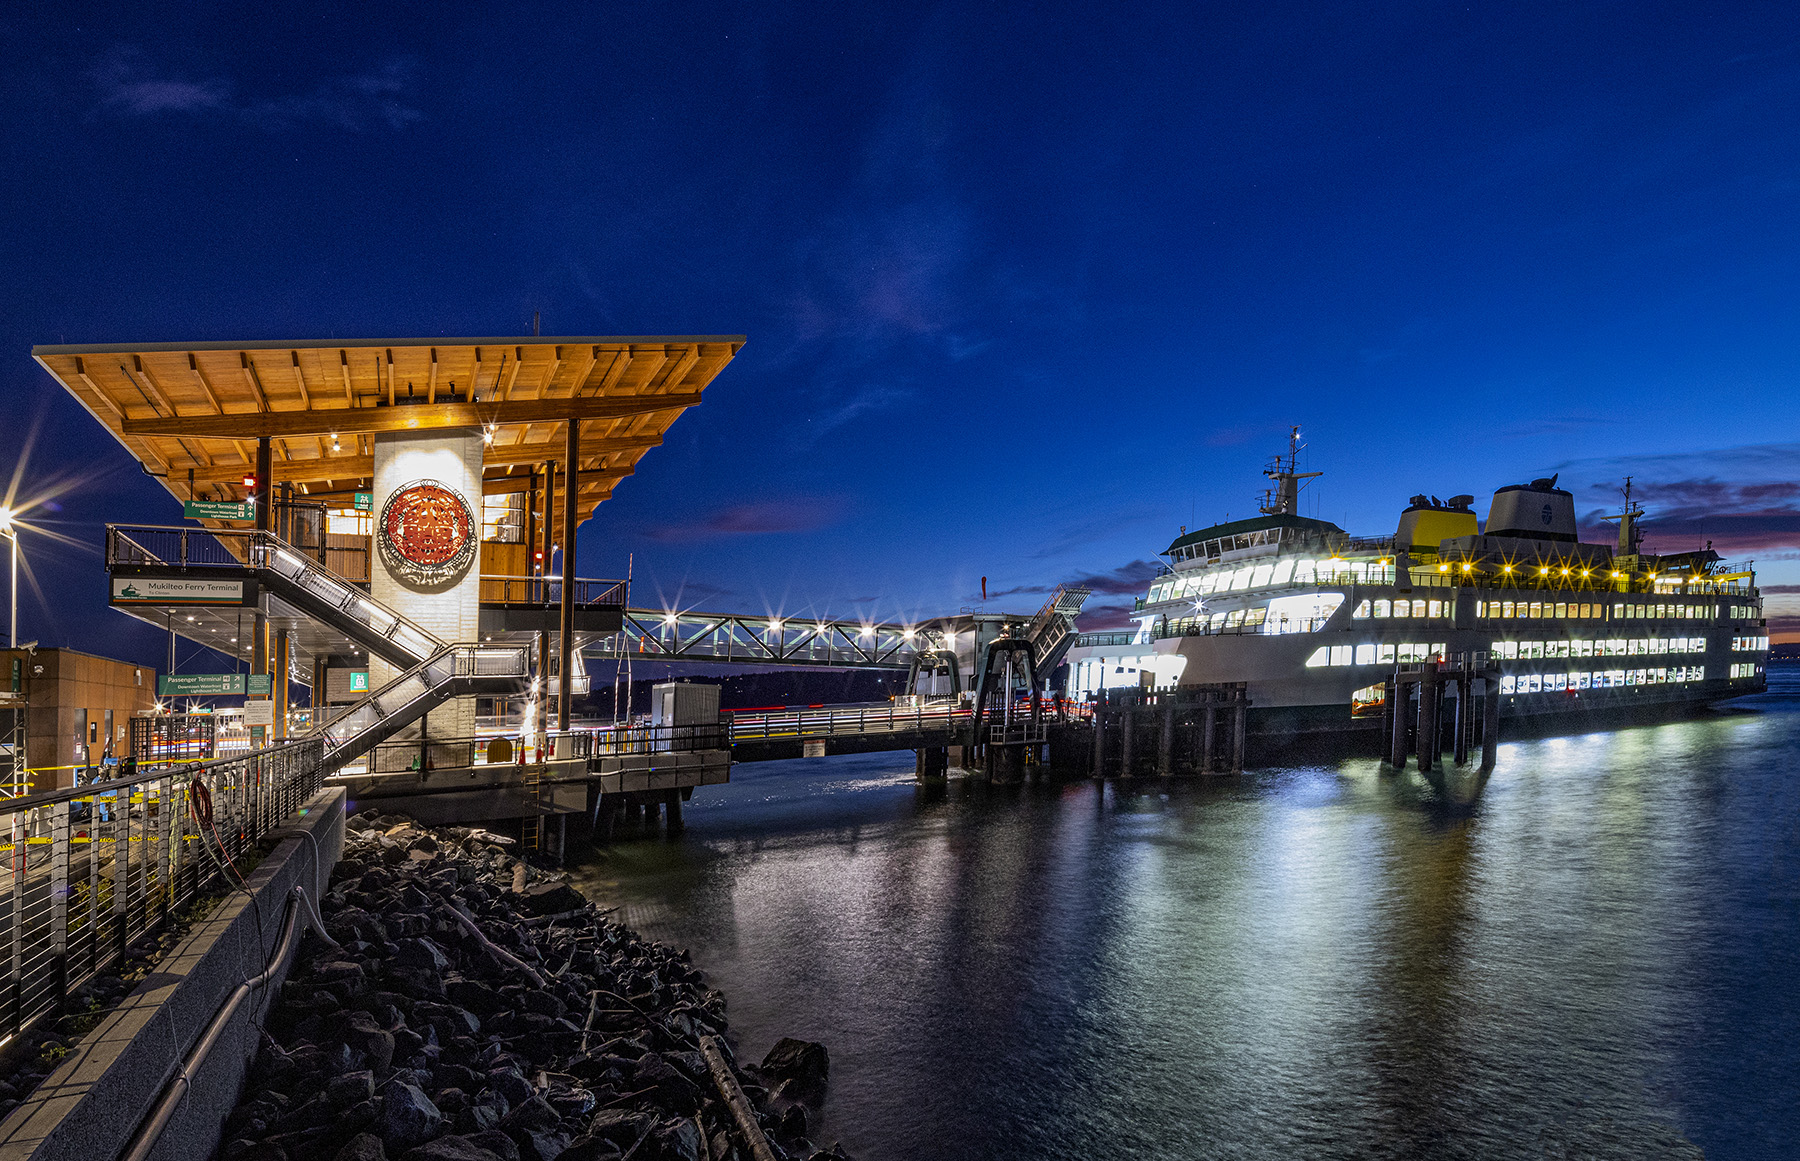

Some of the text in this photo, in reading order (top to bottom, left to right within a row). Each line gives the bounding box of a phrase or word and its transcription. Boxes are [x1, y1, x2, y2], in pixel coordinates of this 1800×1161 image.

[148, 582, 239, 591] Mukilteo Ferry Terminal
